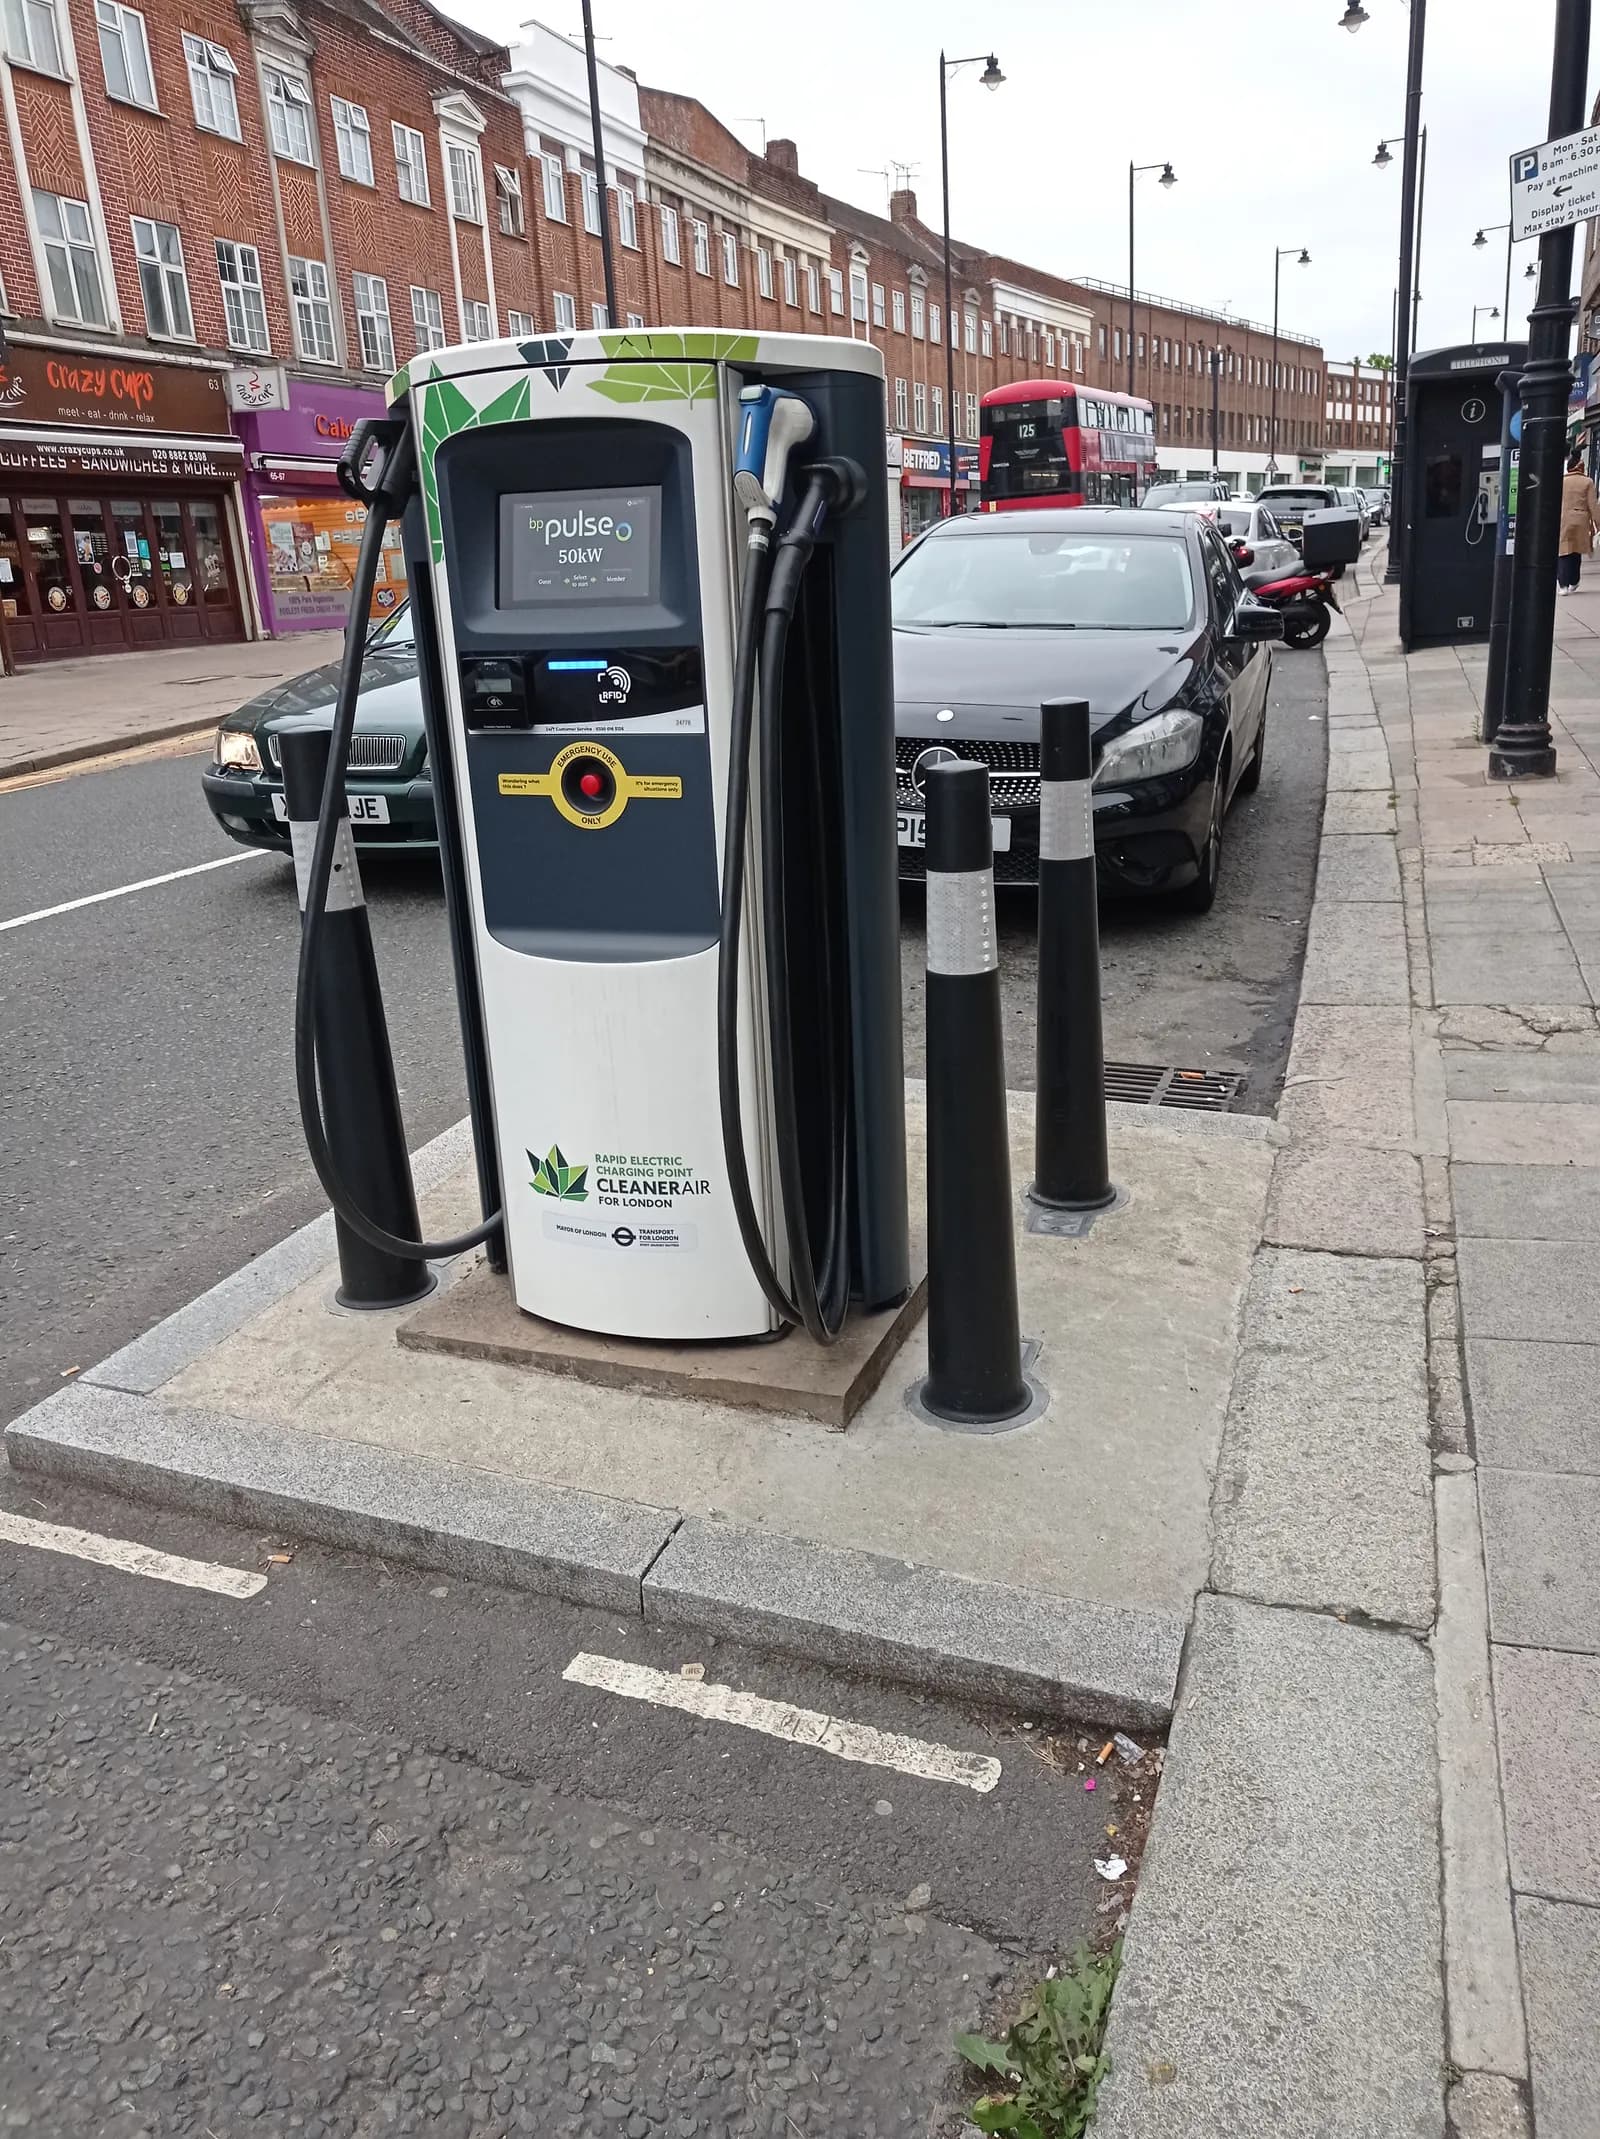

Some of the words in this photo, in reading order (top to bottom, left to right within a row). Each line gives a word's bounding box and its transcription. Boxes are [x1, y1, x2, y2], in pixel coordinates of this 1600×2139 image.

[1553, 143, 1573, 155] Mon
[1581, 133, 1598, 146] Sat
[1542, 162, 1548, 171] 8
[1550, 159, 1564, 168] am
[1571, 146, 1594, 161] 6.30
[1520, 156, 1535, 180] P
[1527, 182, 1544, 193] Pay
[1546, 177, 1556, 186] at
[1559, 163, 1598, 181] machine
[1531, 202, 1565, 219] Display
[1568, 191, 1595, 207] ticket
[1524, 222, 1542, 234] Max
[1545, 214, 1565, 227] stay
[1568, 211, 1574, 220] 2
[1577, 204, 1600, 217] hour
[208, 378, 219, 391] 63
[58, 407, 80, 418] meet
[88, 409, 101, 418] eat
[109, 411, 129, 421] drink
[136, 413, 155, 423] relax
[1019, 424, 1035, 438] 125
[36, 445, 125, 457] www.crazycups.co.uk
[152, 450, 167, 460] 020
[903, 448, 940, 470] BETFRED
[81, 456, 168, 473] SANDWICHES
[172, 462, 181, 474] &
[529, 517, 544, 532] bp
[545, 509, 614, 545] pulse
[558, 547, 603, 564] 50kW
[602, 691, 623, 699] RFID
[557, 746, 602, 768] EMERGENCY
[602, 752, 616, 768] USE
[581, 816, 601, 825] ONLY
[595, 1154, 627, 1165] RAPID
[630, 1156, 683, 1166] ELECTRIC
[596, 1166, 654, 1177] CHARGING
[657, 1168, 693, 1178] POINT
[599, 1197, 620, 1206] FOR
[623, 1198, 673, 1208] LONDON
[556, 1225, 574, 1233] MAYOR
[582, 1229, 607, 1238] LONDON
